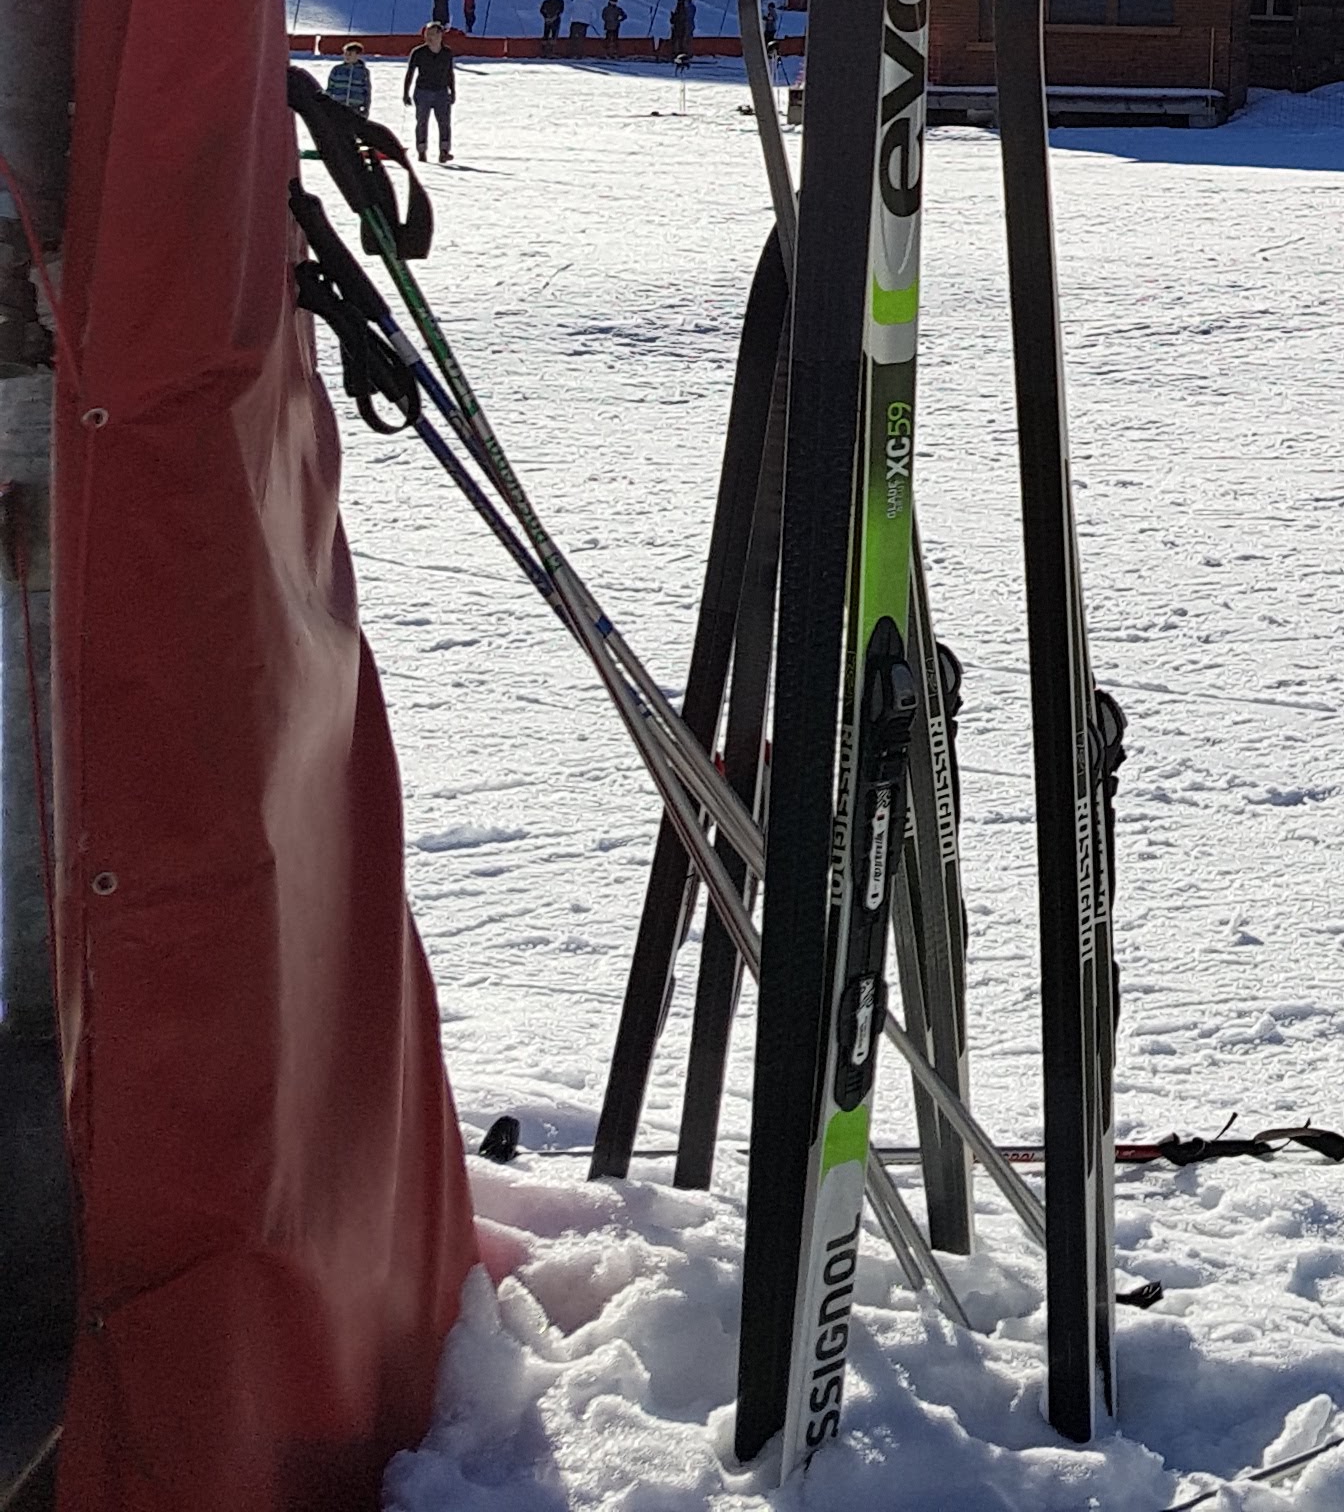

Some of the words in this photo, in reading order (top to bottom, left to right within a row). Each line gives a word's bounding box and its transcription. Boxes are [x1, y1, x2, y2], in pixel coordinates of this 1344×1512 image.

[886, 401, 912, 481] XC59
[928, 715, 957, 864] ROSSIGNOL
[1076, 796, 1095, 961] ROSSIGNOL
[804, 1212, 862, 1466] SSIGNOL
